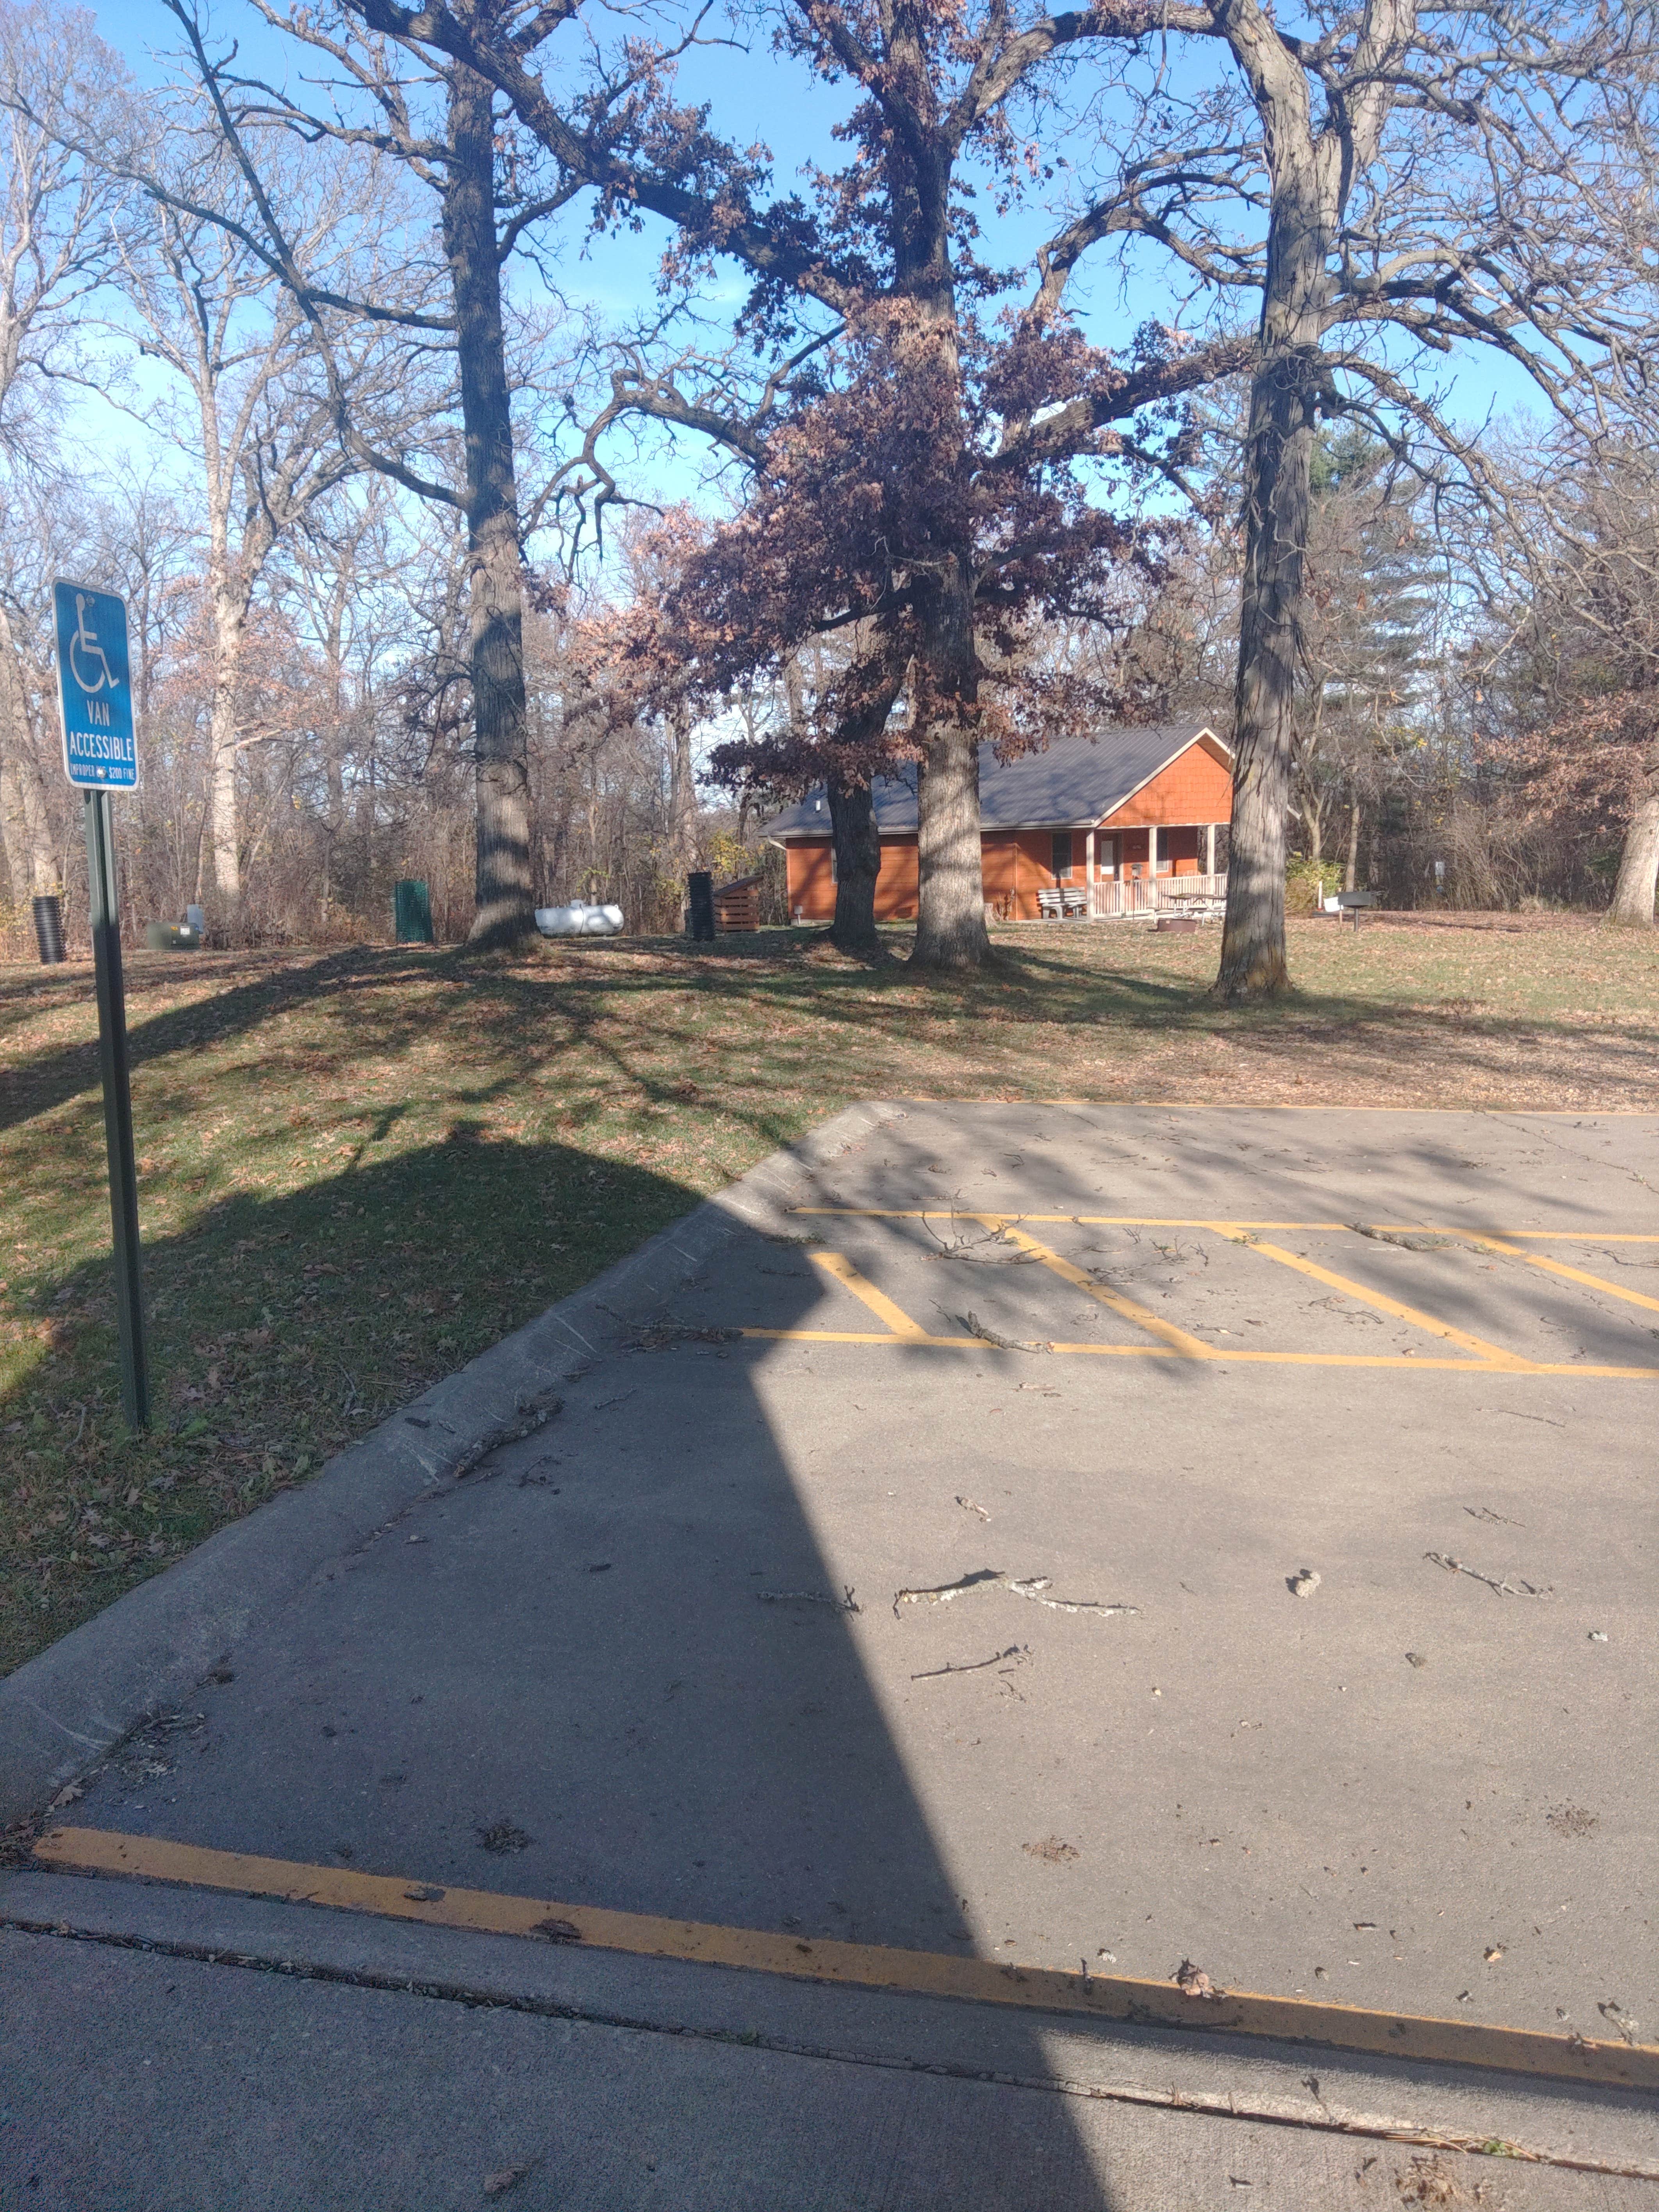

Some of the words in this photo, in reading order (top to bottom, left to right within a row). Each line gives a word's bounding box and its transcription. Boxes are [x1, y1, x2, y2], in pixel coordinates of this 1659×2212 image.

[87, 699, 110, 726] VAN
[70, 731, 133, 761] ACCESSIBLE
[70, 763, 95, 777] IMPROPER
[109, 766, 122, 779] $200
[123, 768, 135, 780] FINE
